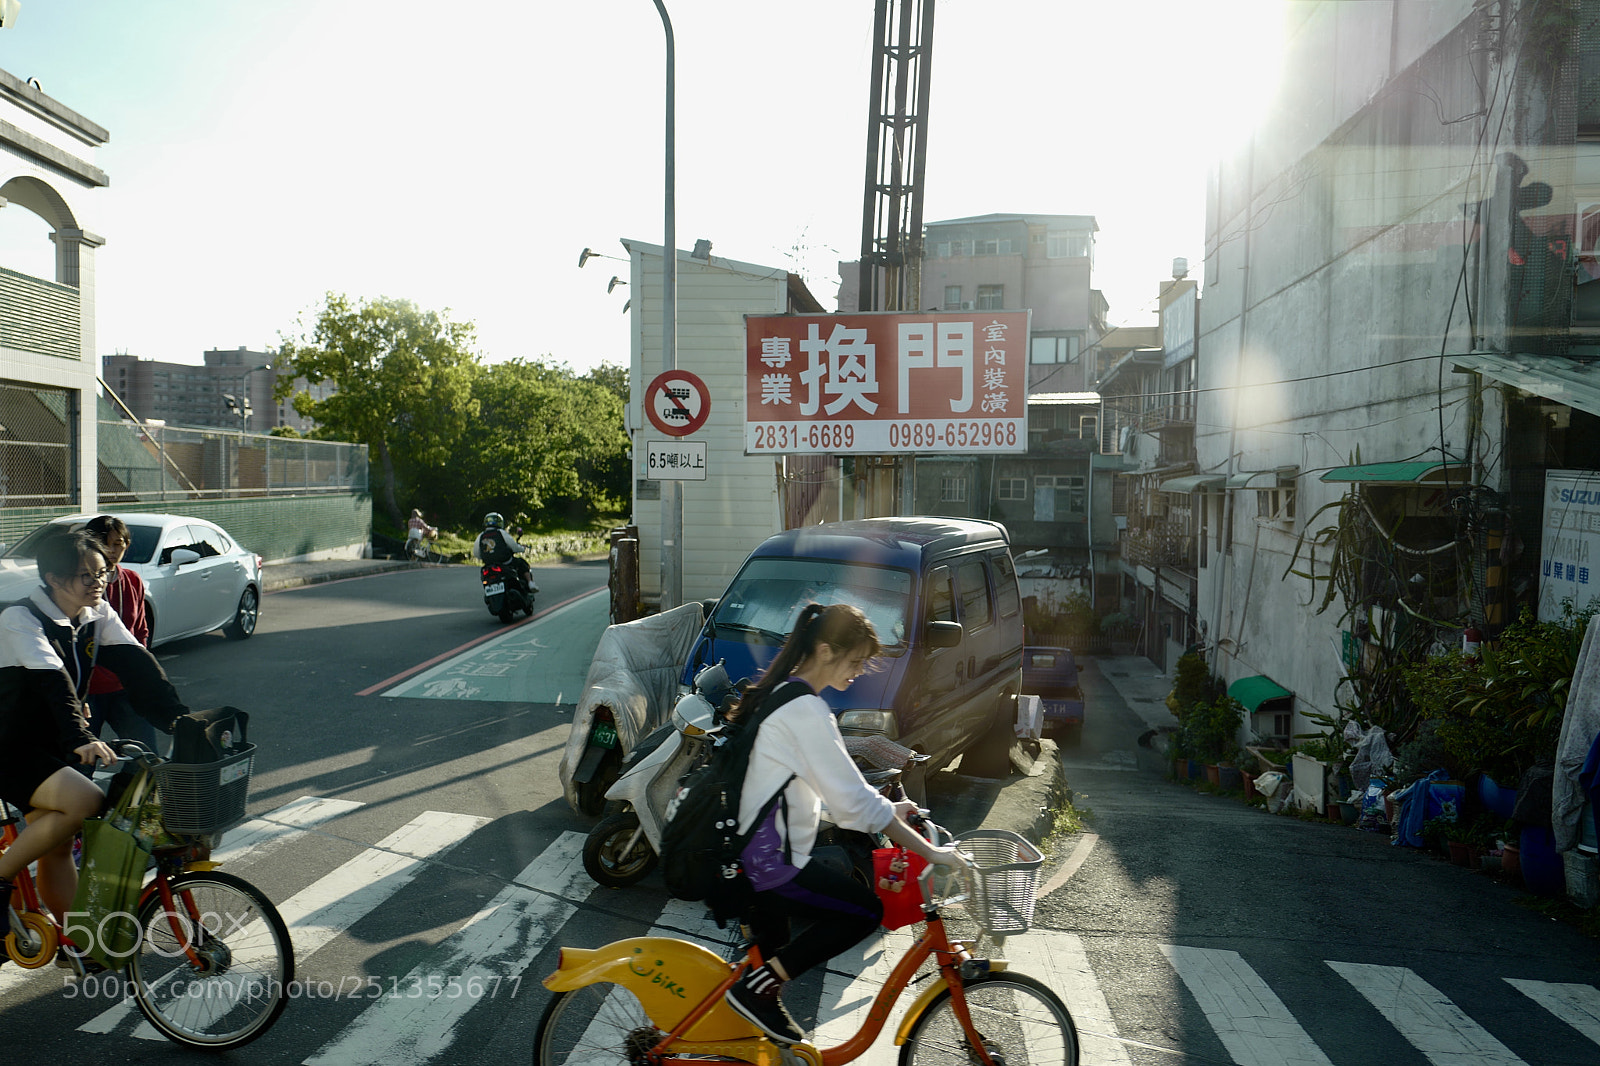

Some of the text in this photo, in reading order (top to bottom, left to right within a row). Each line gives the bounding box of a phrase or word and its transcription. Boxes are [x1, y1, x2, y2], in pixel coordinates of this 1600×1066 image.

[761, 336, 792, 405] 專業
[799, 321, 975, 416] 換門
[981, 319, 1009, 413] 室內裝潢
[754, 421, 1017, 449] 2831-6689 0989-652968
[650, 452, 704, 469] 6.5噸以上
[1543, 560, 1589, 585] 山葉機車
[447, 638, 549, 678] 人行道
